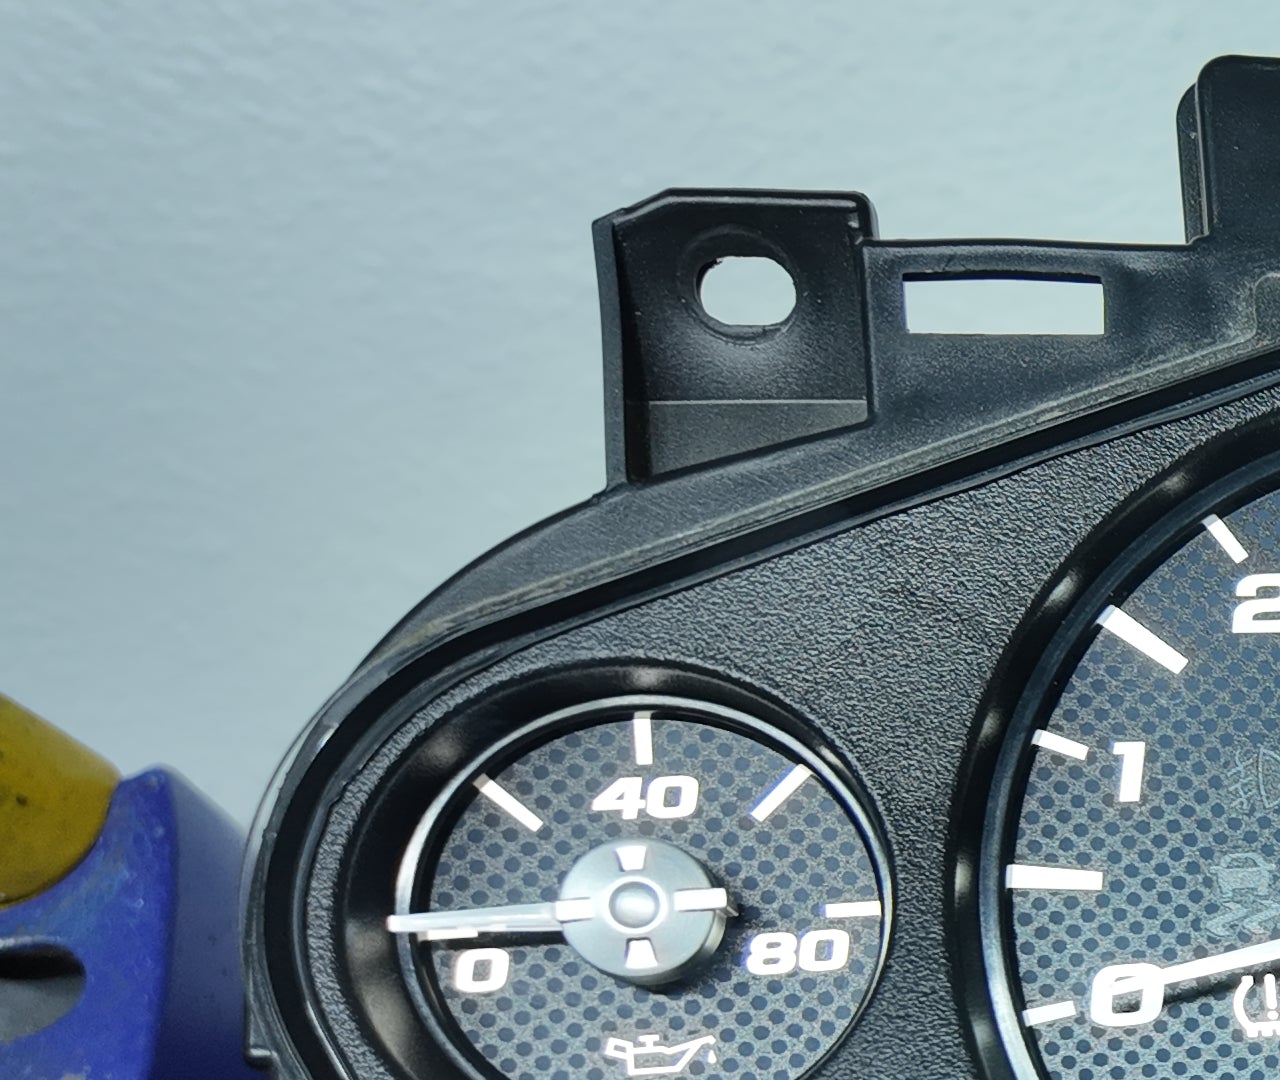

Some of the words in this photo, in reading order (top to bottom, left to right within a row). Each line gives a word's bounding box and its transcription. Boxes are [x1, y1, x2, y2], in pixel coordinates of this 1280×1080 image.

[1112, 741, 1146, 802] 1
[592, 774, 700, 820] 40
[454, 947, 510, 994] 0
[745, 928, 851, 976] 80
[1091, 962, 1165, 1027] 0
